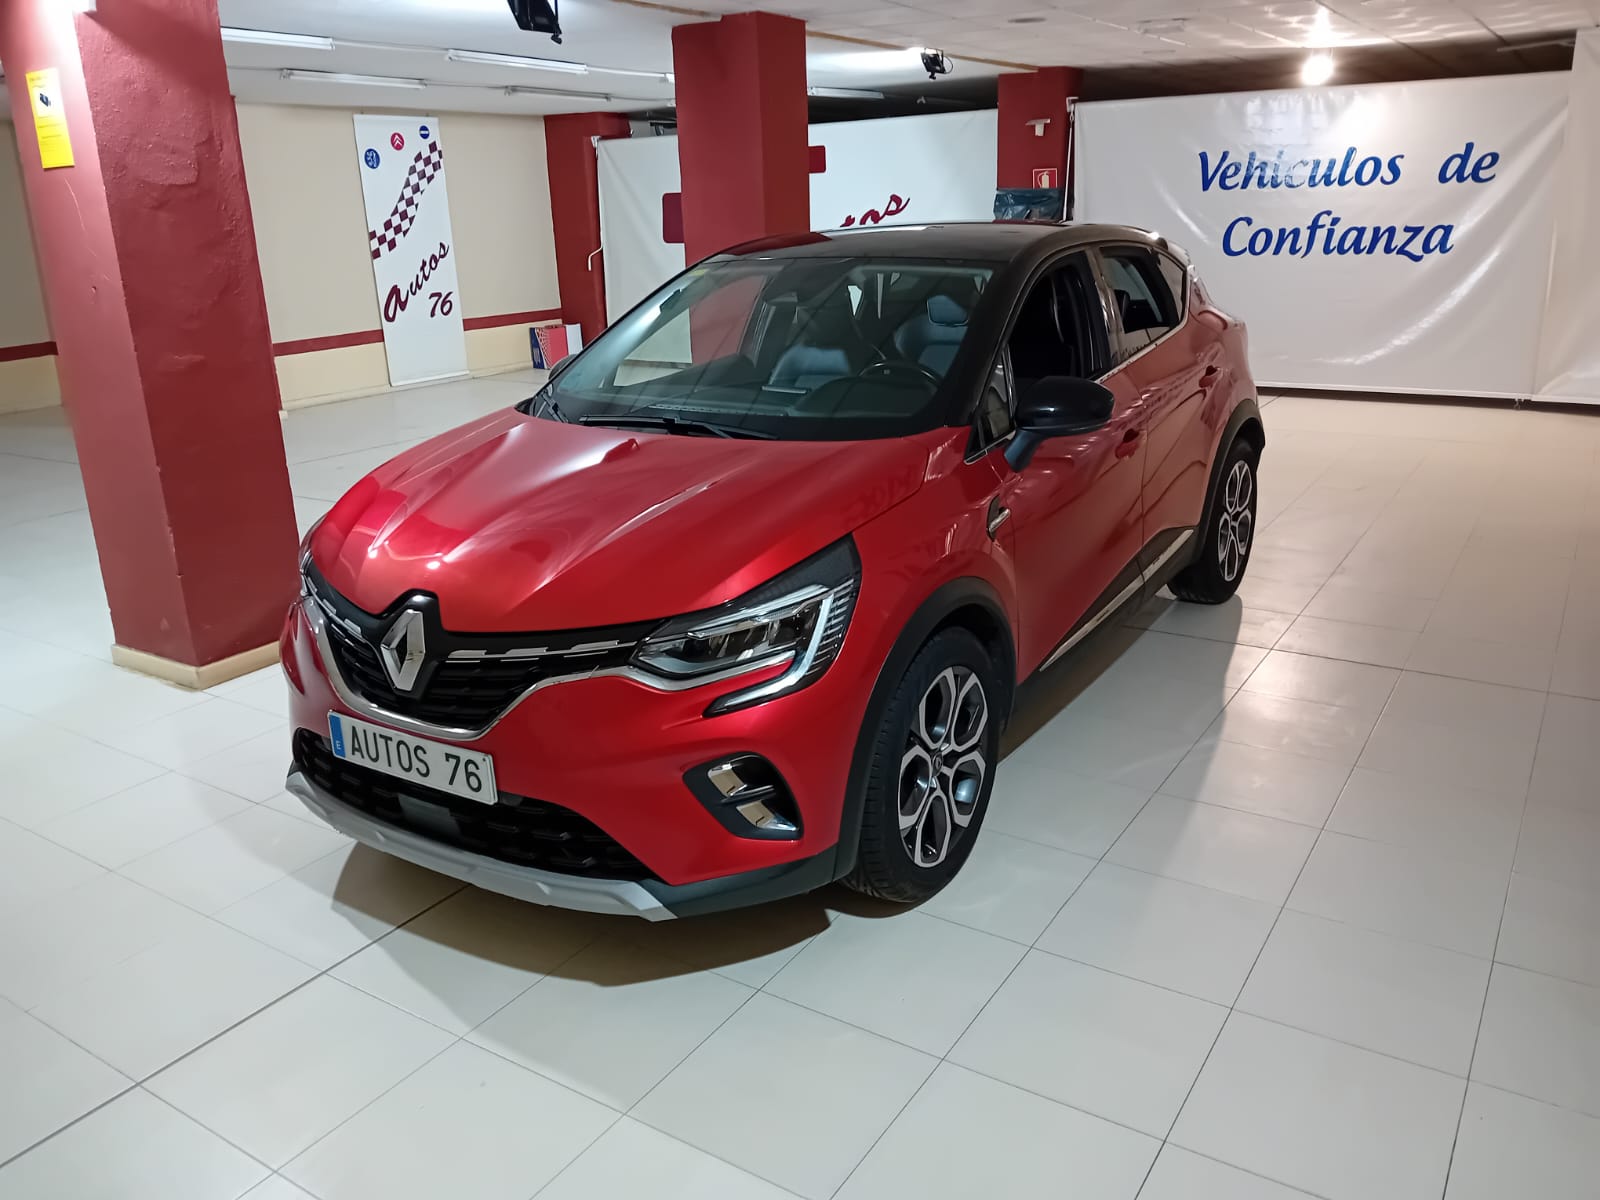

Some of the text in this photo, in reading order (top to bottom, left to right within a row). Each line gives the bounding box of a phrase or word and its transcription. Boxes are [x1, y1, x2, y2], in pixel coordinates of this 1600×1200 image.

[1438, 141, 1500, 185] de
[1222, 209, 1455, 262] Confianza
[427, 291, 454, 318] 76
[335, 740, 342, 750] E
[351, 725, 482, 793] AUTOS 76
